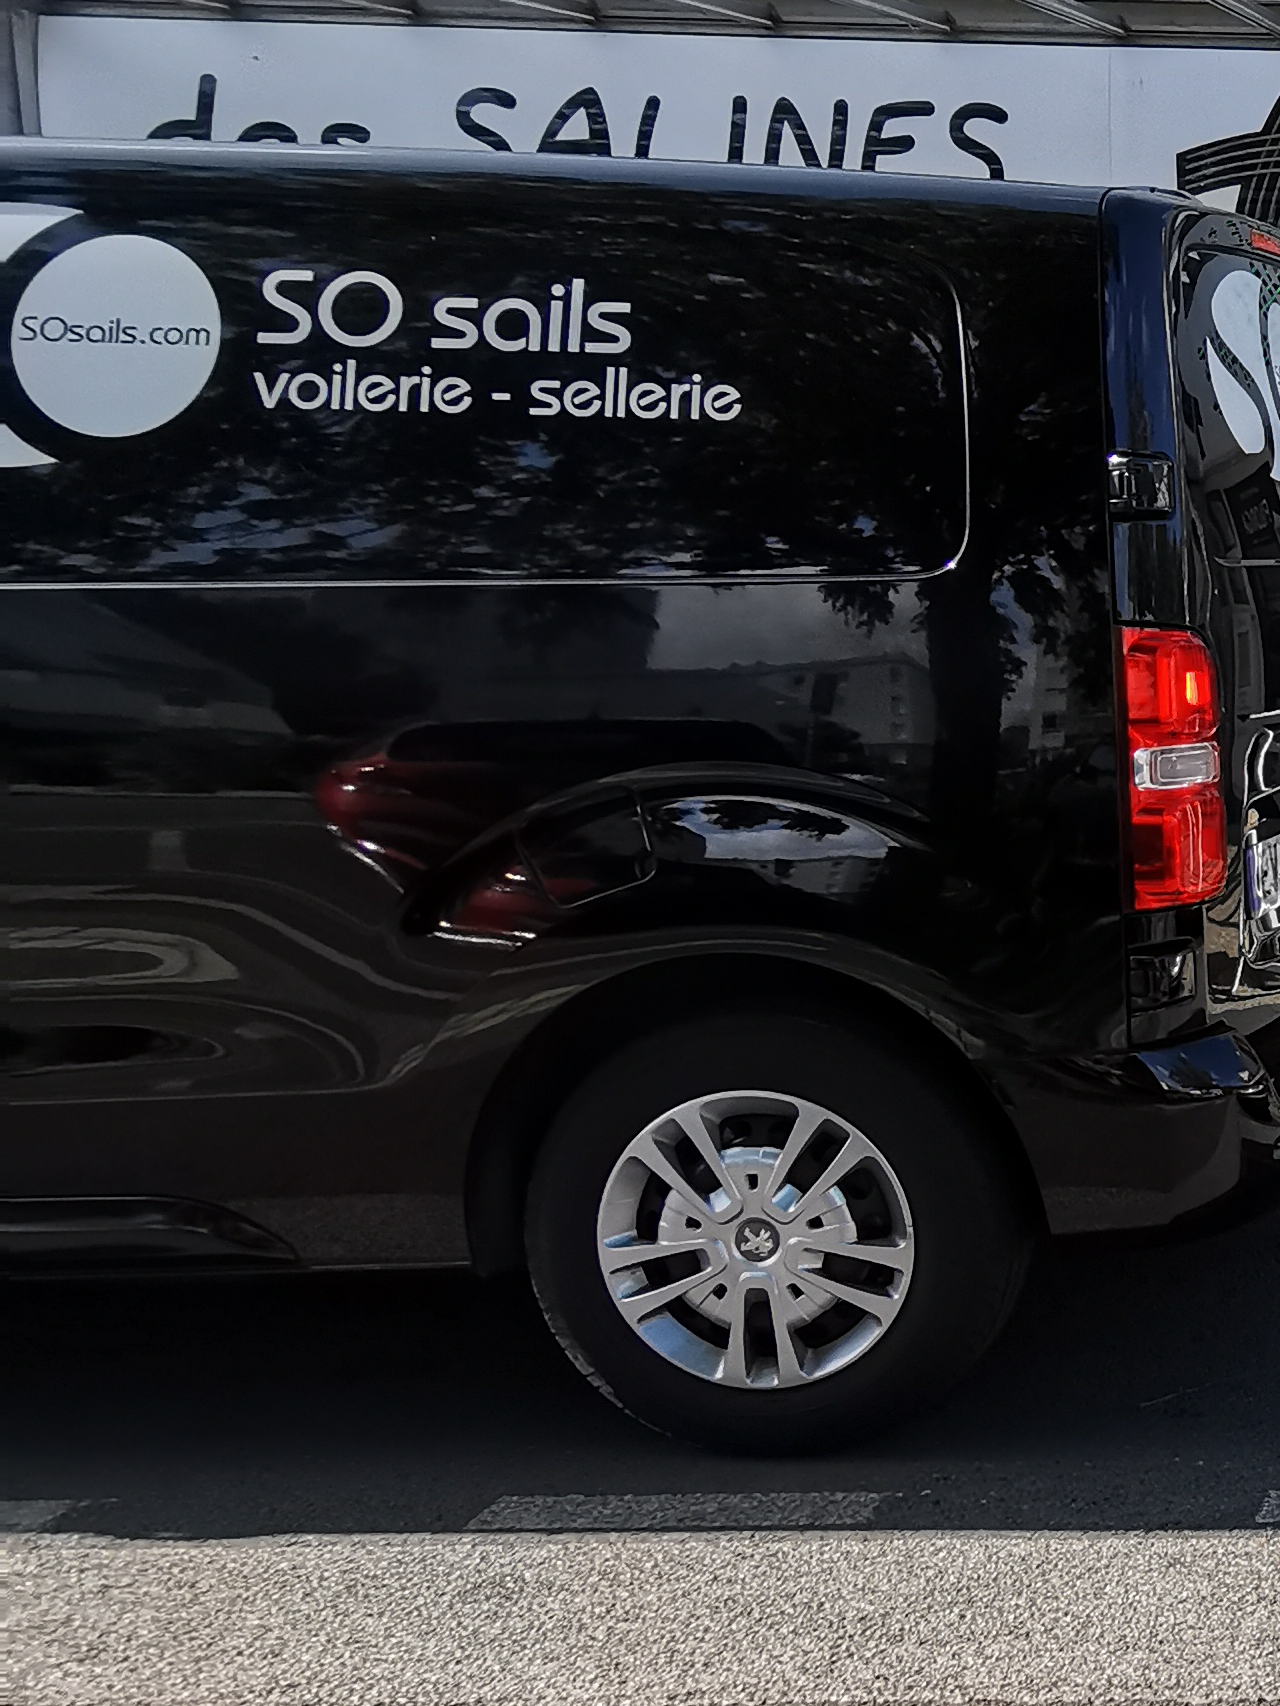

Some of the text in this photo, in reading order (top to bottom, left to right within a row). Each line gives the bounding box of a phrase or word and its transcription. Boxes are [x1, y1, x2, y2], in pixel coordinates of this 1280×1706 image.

[18, 315, 211, 346] SOsails.com
[256, 269, 632, 354] SO sails
[253, 359, 472, 414] voilerie
[529, 366, 743, 421] sellerie
